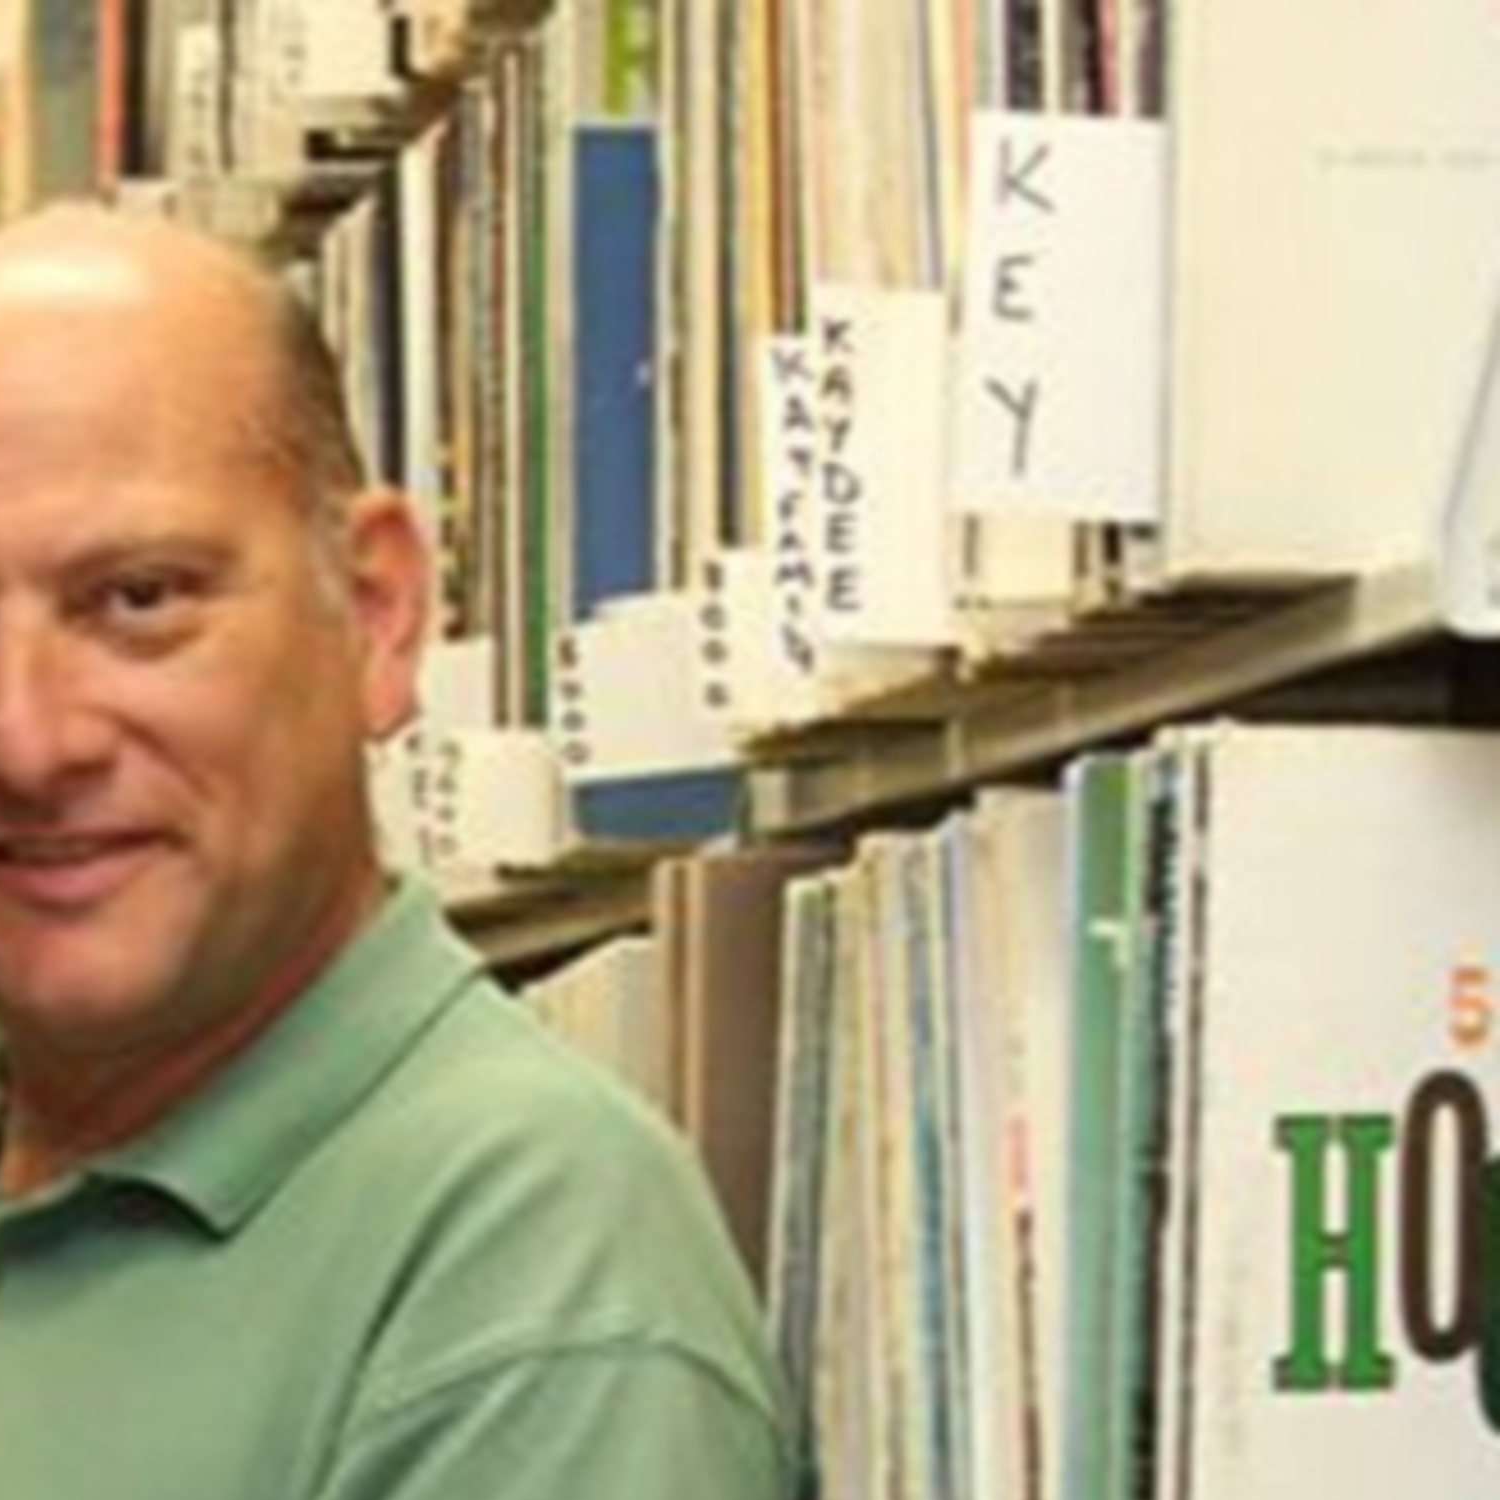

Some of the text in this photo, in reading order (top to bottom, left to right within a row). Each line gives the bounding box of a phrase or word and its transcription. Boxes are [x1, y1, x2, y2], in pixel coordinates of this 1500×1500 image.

[819, 316, 861, 612] KAYDEE
[984, 136, 1057, 478] KEY
[1449, 965, 1488, 1046] 5
[1272, 1068, 1500, 1436] HO
